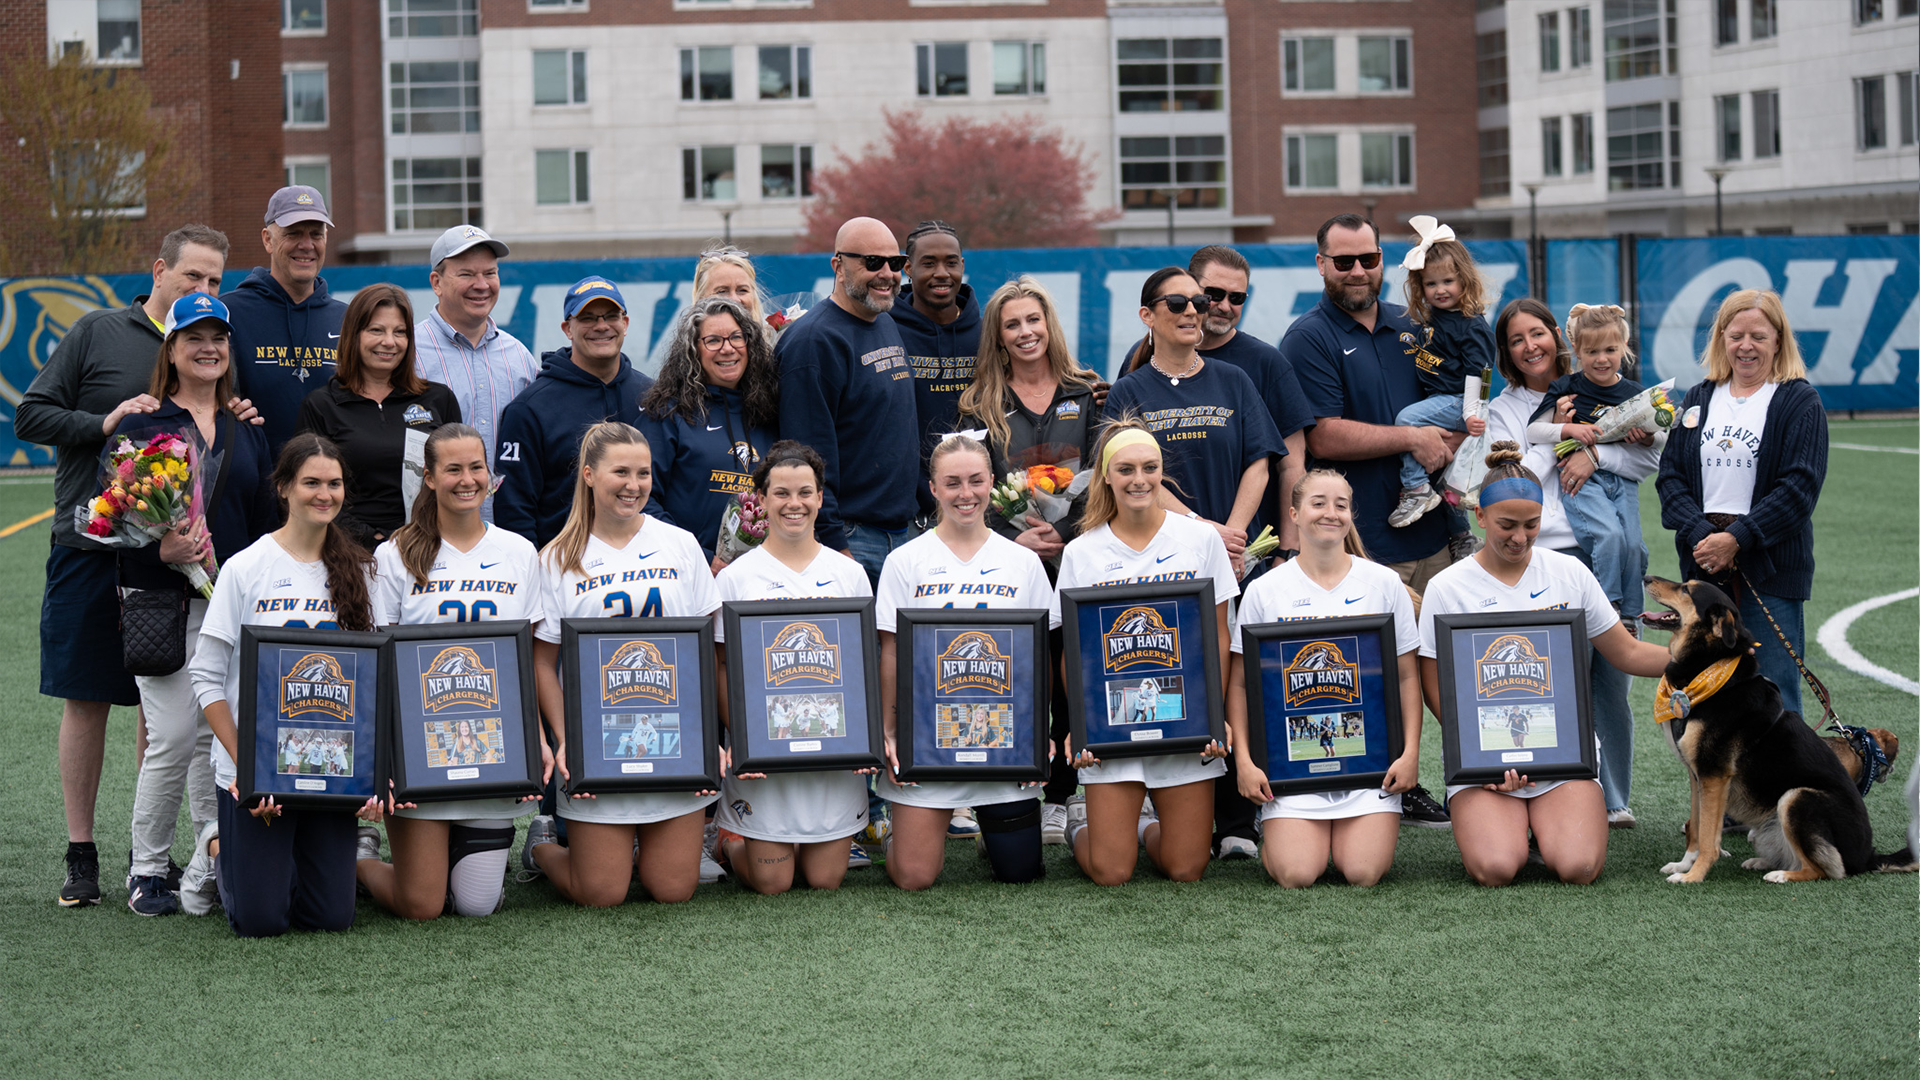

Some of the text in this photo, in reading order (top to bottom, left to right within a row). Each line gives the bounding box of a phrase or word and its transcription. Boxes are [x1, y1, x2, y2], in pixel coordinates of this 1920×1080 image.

[256, 346, 338, 360] NEW HAVEN
[278, 358, 322, 367] LACOSSE
[874, 358, 892, 373] NEW
[908, 356, 977, 367] NIVERSITY
[942, 367, 977, 379] HAVE
[1142, 405, 1234, 422] NIVERSITY OF
[1148, 417, 1178, 432] NEW
[1166, 431, 1207, 441] LACROSSE
[500, 441, 521, 461] 21
[1706, 457, 1753, 468] CROSS
[710, 472, 736, 485] NEW
[410, 579, 519, 596] NEW HAVEN
[575, 568, 679, 597] NEW HAVEN
[914, 583, 1019, 599] NEW HAVEN
[256, 598, 338, 613] NEW HAV
[603, 586, 664, 617] 24
[1109, 633, 1173, 657] NEW HAVEN
[771, 650, 834, 671] NEW HAVEN
[1118, 650, 1167, 663] CHARGERS
[779, 664, 828, 677] CHARGERS
[942, 660, 1005, 680] NEW HAVEN
[1482, 662, 1545, 682] NEW HAVEN
[428, 675, 492, 697] NEW HAVEN
[608, 671, 670, 689] NEW HAVEN
[950, 674, 998, 687] CHARGERS
[1290, 669, 1354, 692] NEW HAVEN
[1490, 677, 1539, 689] CHARGERS
[287, 682, 349, 705] NEW HAVEN
[437, 691, 486, 704] CHARGERS
[615, 684, 664, 696] CHARGERS
[1298, 685, 1347, 698] CHARGERS
[293, 698, 341, 712] CHARGERS
